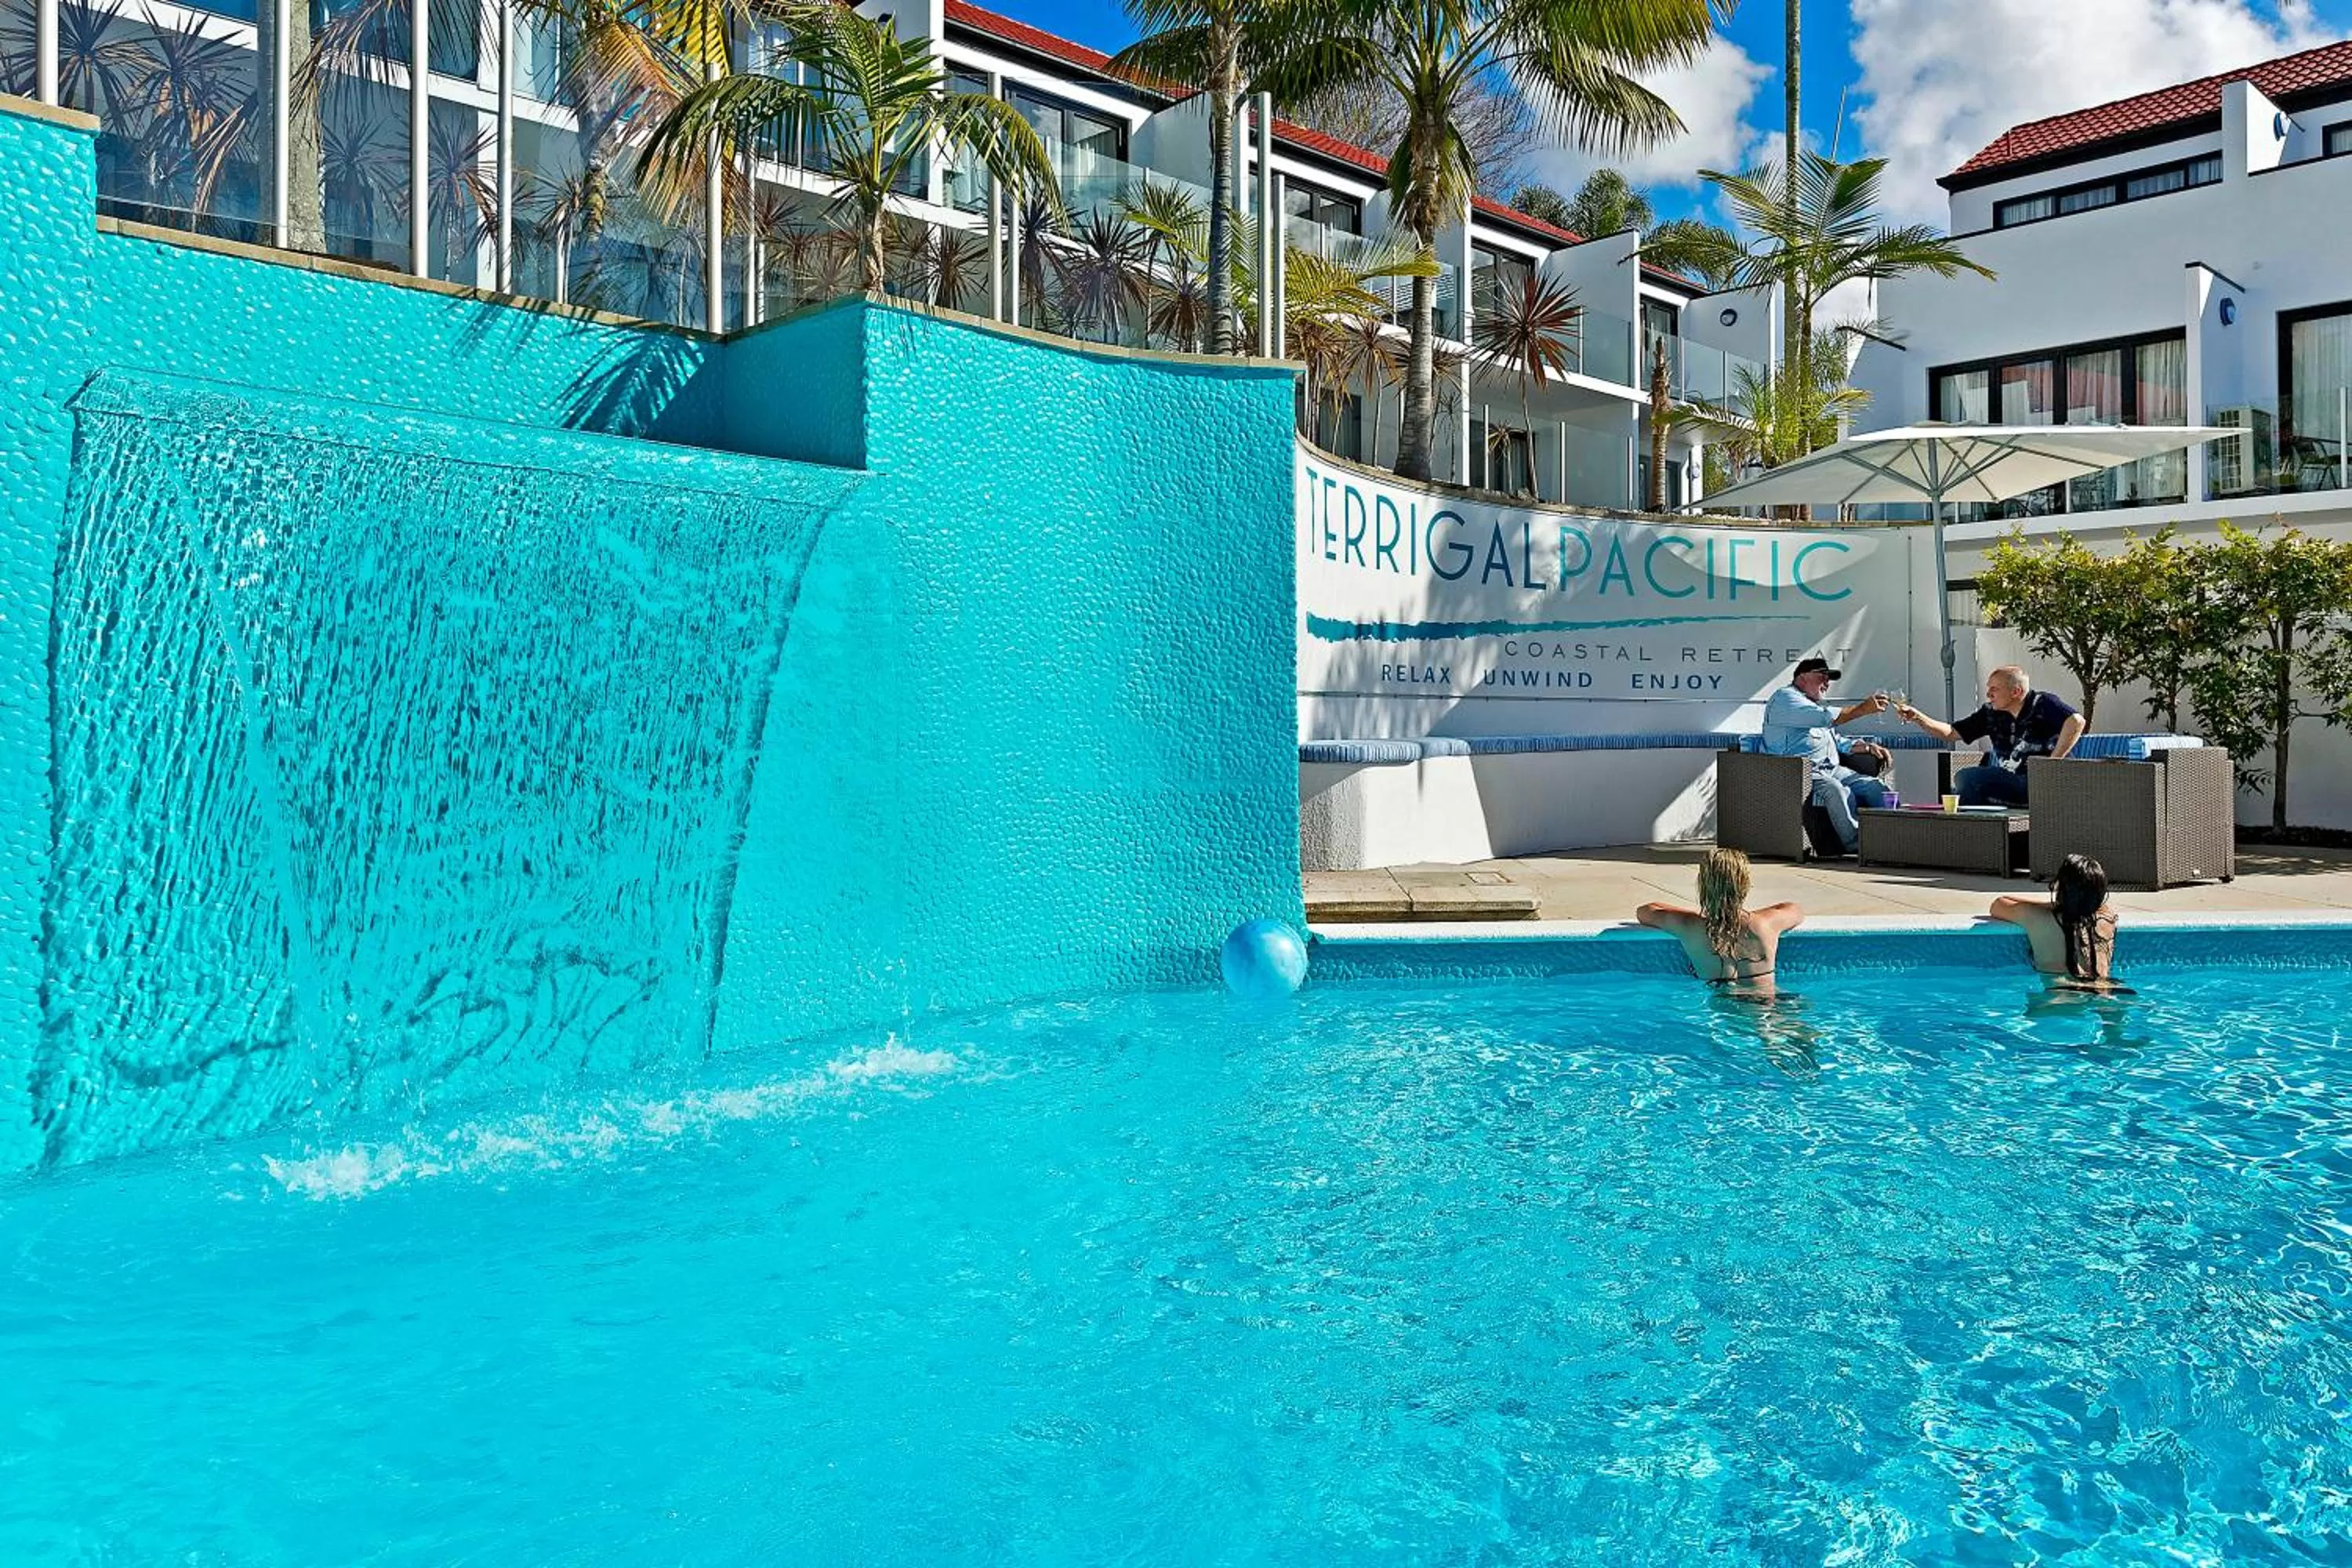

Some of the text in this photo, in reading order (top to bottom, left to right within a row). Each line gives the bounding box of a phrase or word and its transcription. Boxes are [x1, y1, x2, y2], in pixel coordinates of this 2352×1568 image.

[1504, 641, 1852, 663] COASTAL RETREAT
[1381, 664, 1723, 690] RELAX UNWIND ENJOY
